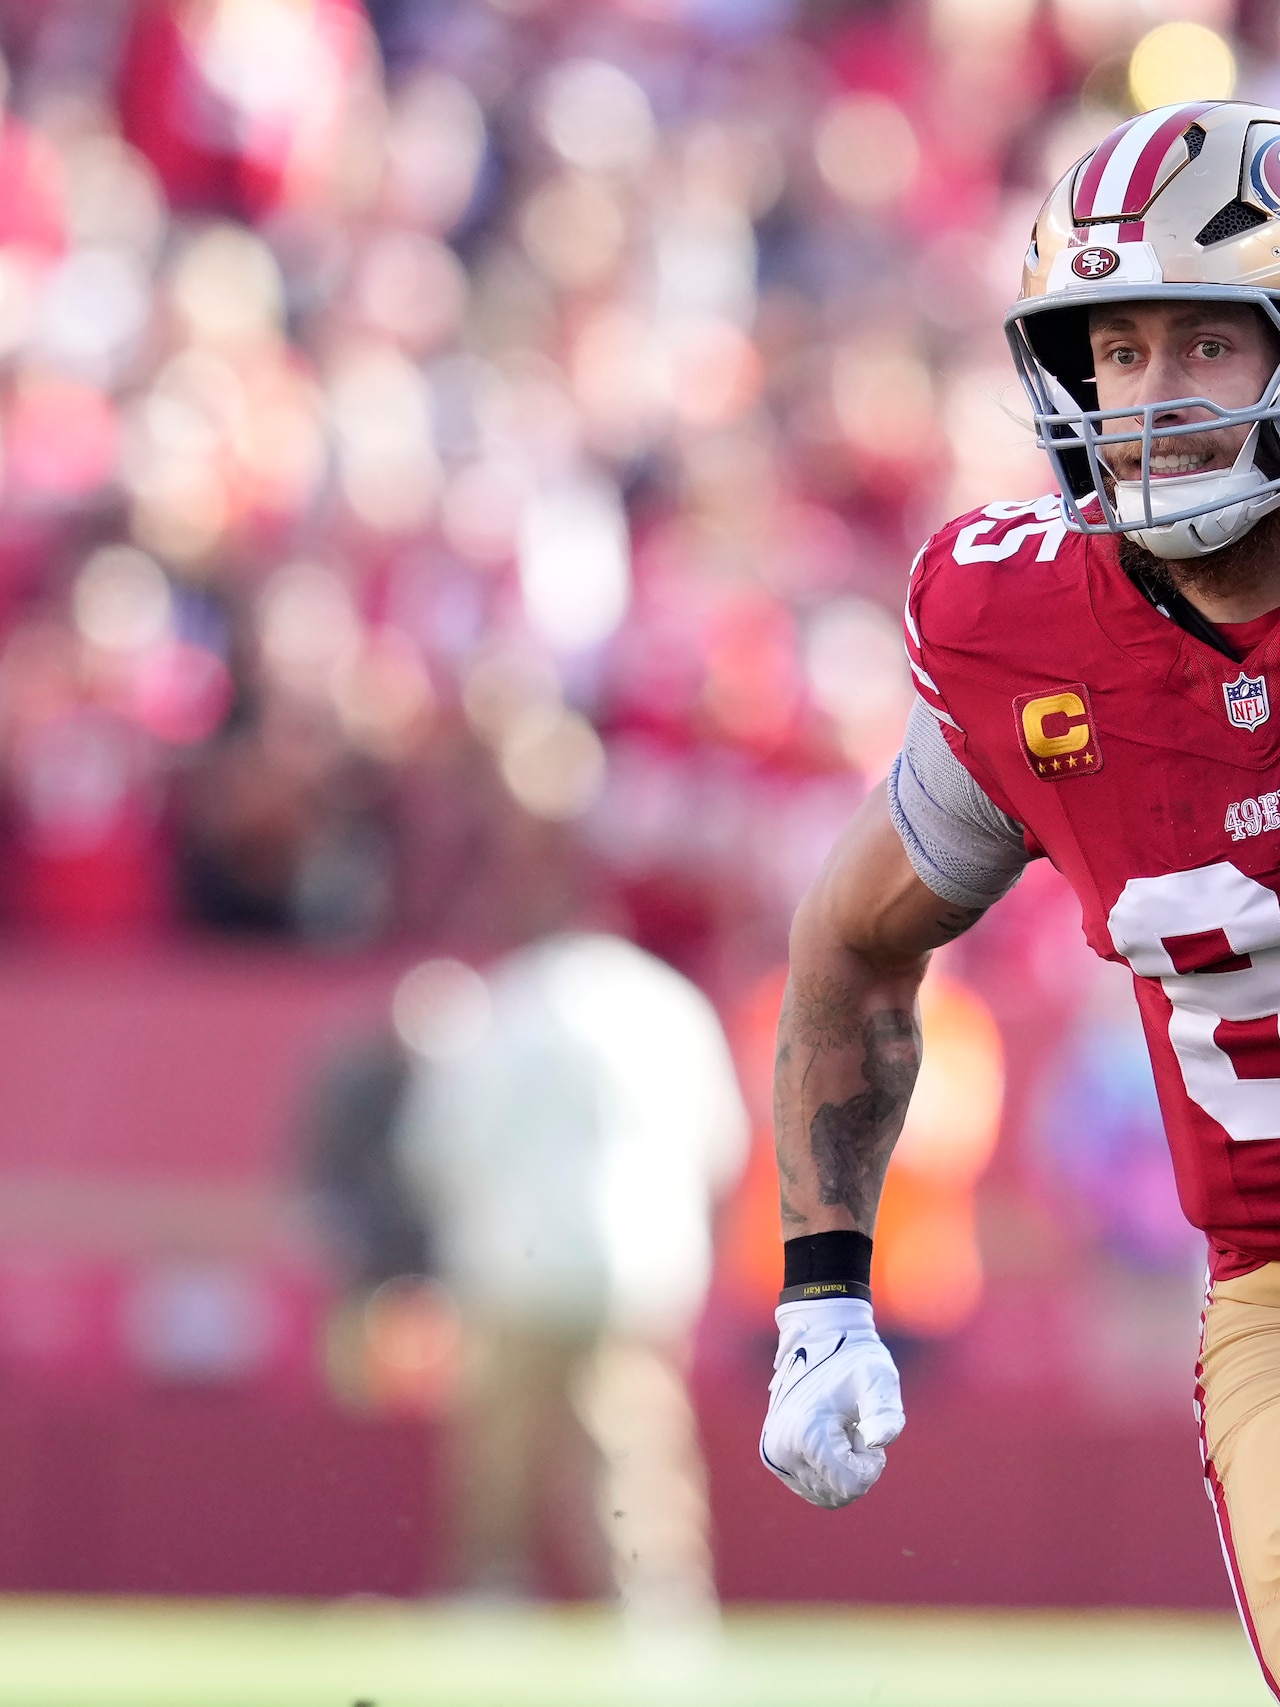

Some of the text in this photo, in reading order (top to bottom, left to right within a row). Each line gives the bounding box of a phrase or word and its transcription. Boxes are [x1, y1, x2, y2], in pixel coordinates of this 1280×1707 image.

[951, 490, 1098, 566] 85
[1022, 692, 1090, 758] C
[1232, 698, 1263, 722] NFL
[822, 1284, 848, 1293] Team
